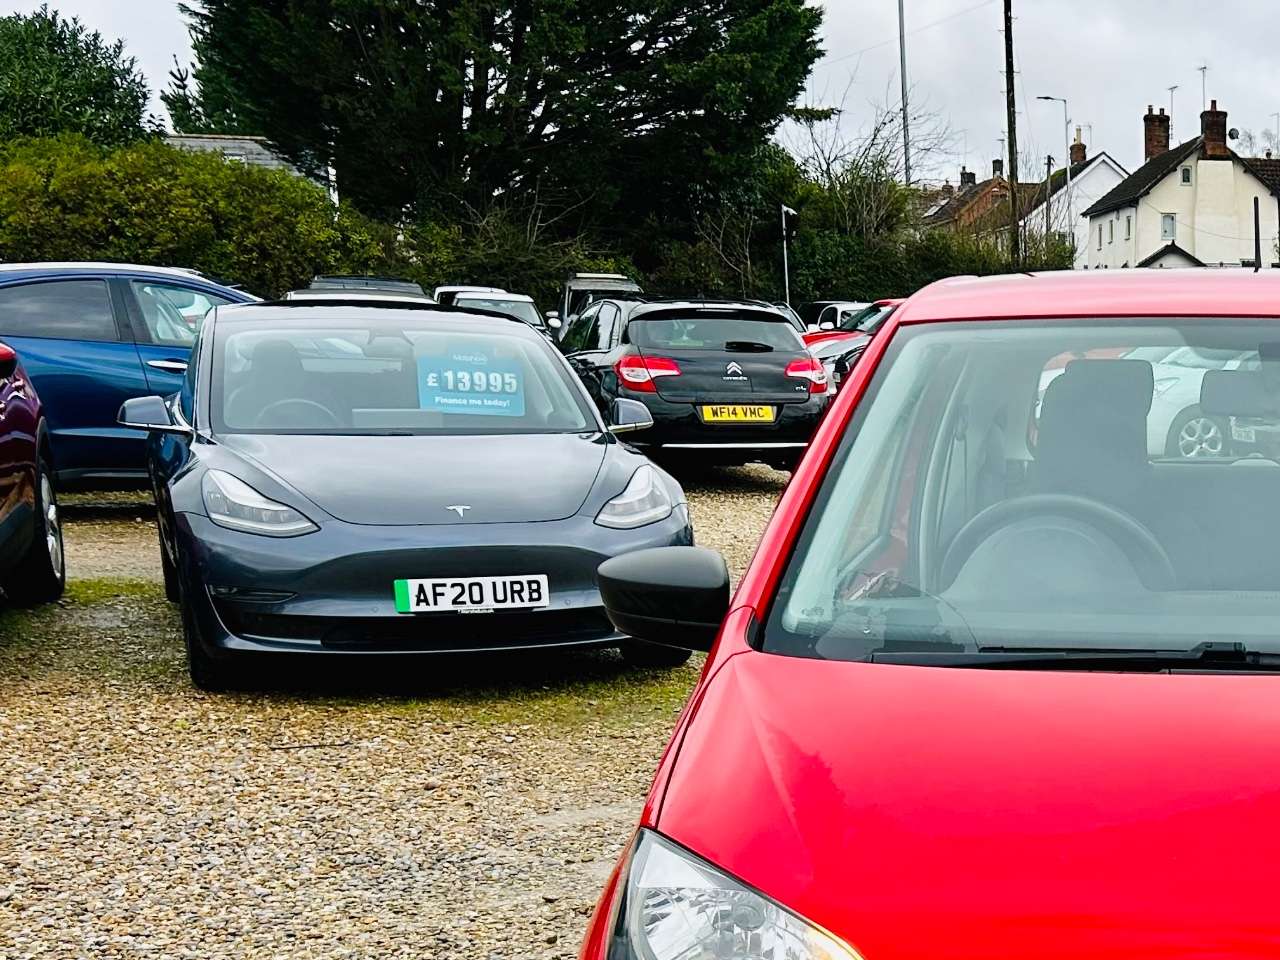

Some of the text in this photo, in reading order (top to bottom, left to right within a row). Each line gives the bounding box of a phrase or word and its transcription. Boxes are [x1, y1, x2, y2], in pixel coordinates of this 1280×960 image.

[434, 396, 467, 405] Finance
[710, 406, 765, 418] WF14 VMC
[415, 579, 542, 607] AF20 URB
